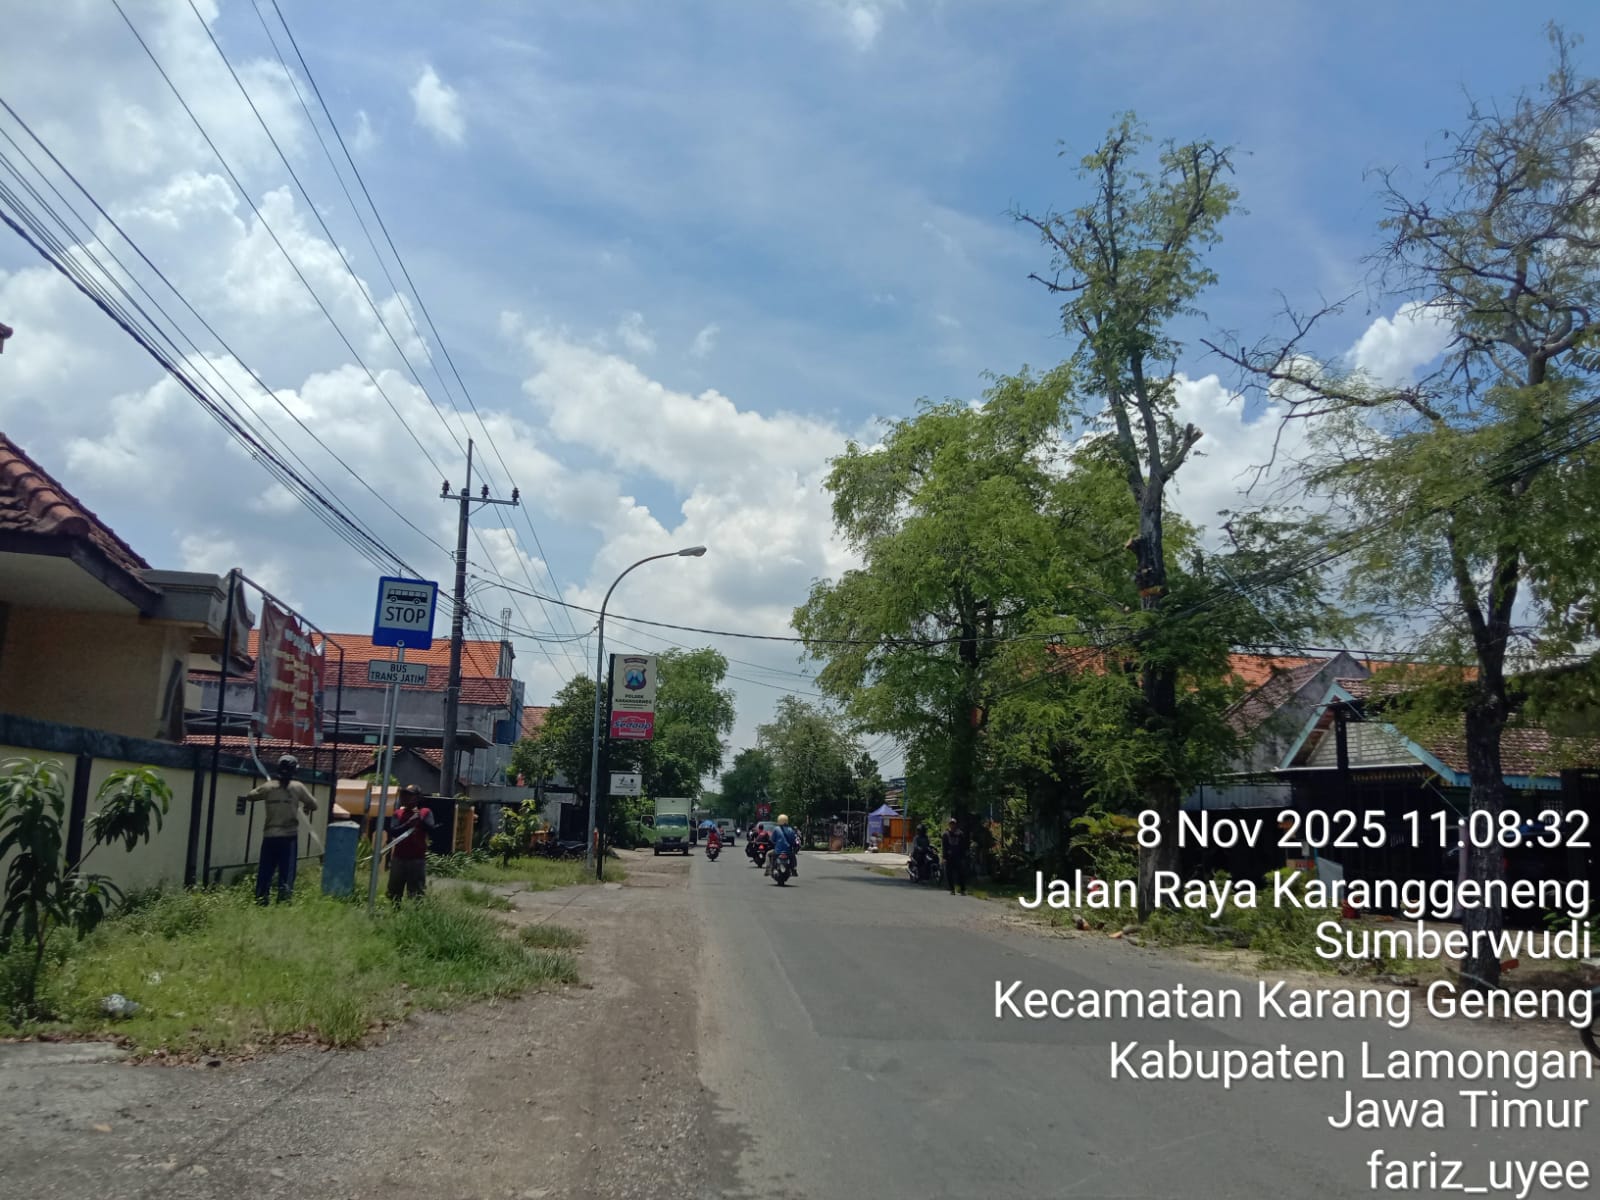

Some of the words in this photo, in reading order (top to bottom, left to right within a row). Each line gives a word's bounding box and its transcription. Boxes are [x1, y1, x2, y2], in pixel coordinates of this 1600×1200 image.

[385, 606, 426, 623] STOP
[390, 664, 408, 673] BUS
[370, 671, 398, 682] TRANS
[400, 674, 424, 683] JATIM
